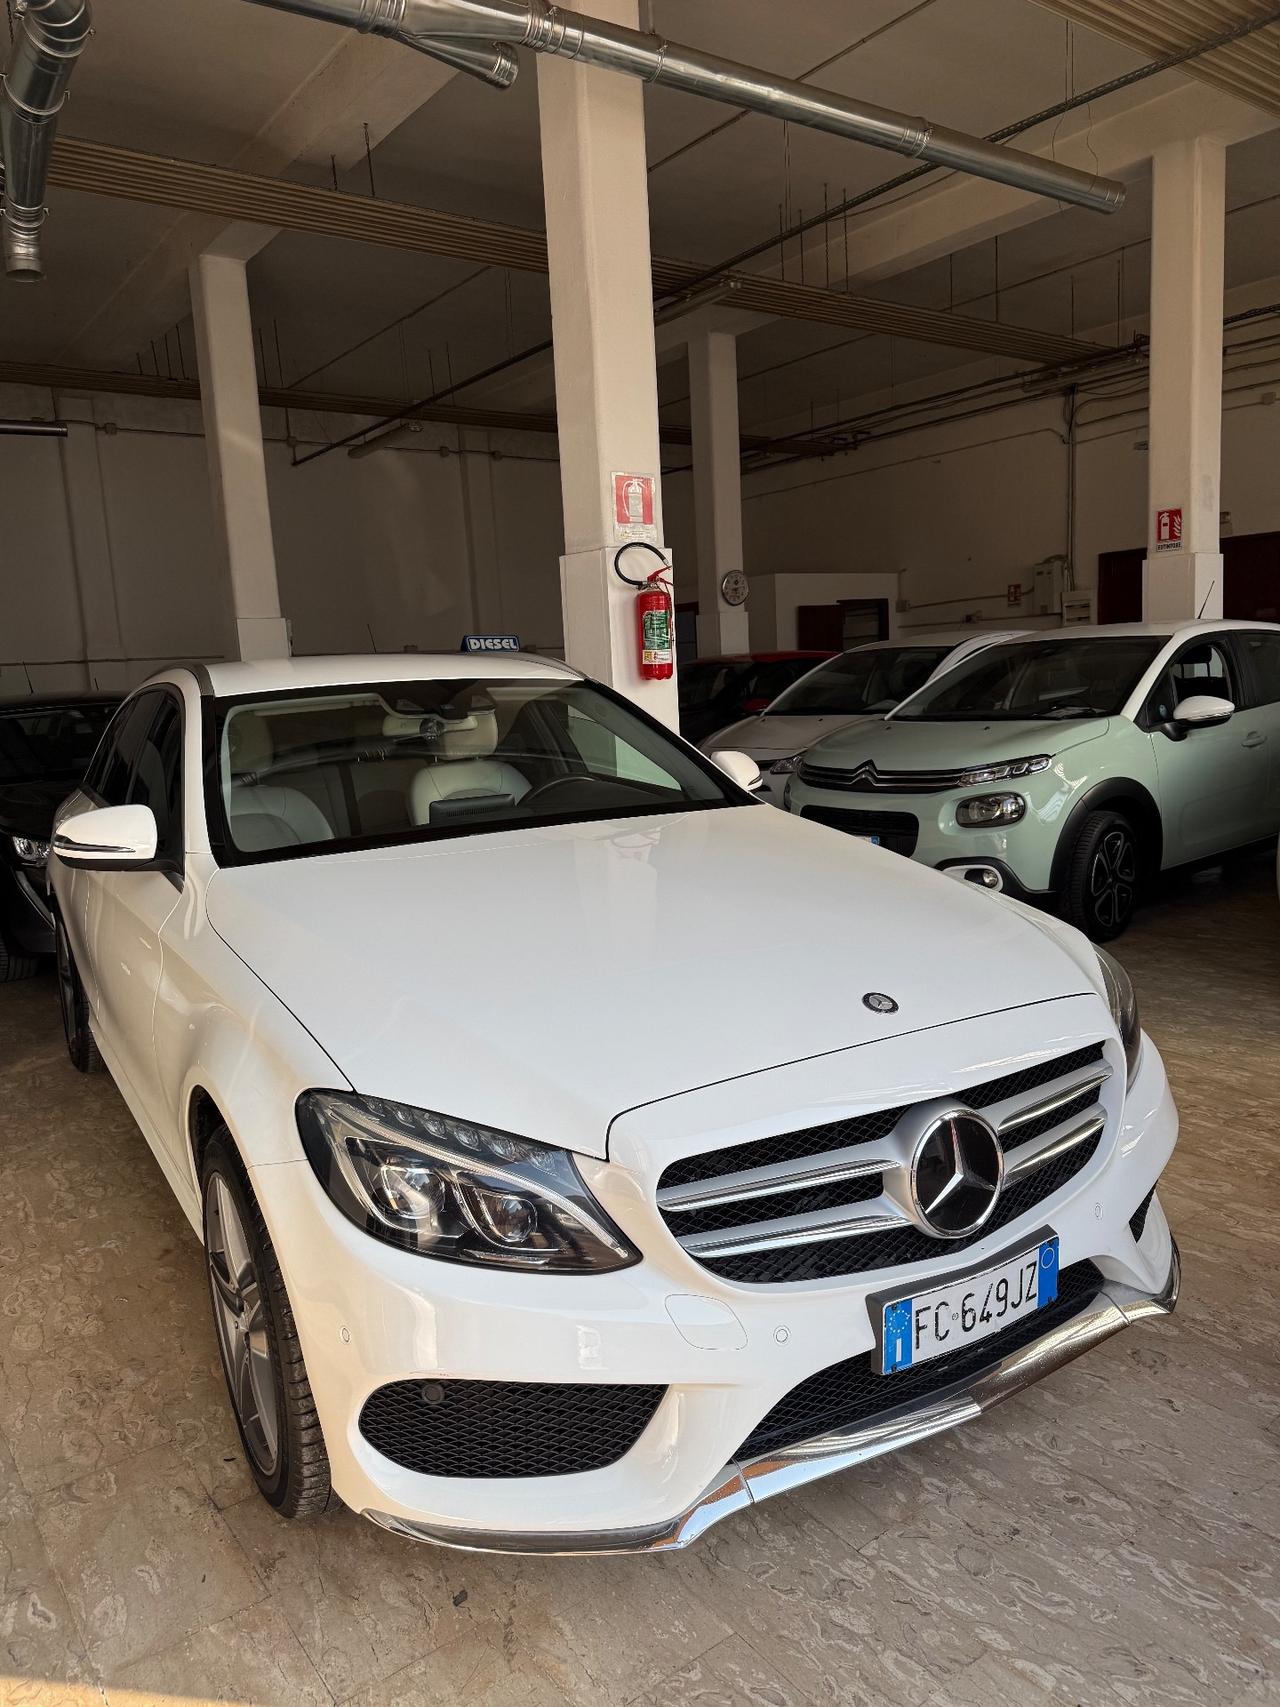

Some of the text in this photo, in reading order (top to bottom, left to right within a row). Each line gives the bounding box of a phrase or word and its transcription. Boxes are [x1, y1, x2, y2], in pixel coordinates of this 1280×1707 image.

[468, 638, 517, 650] DIESEL
[915, 1260, 1038, 1350] FC 649JZ
